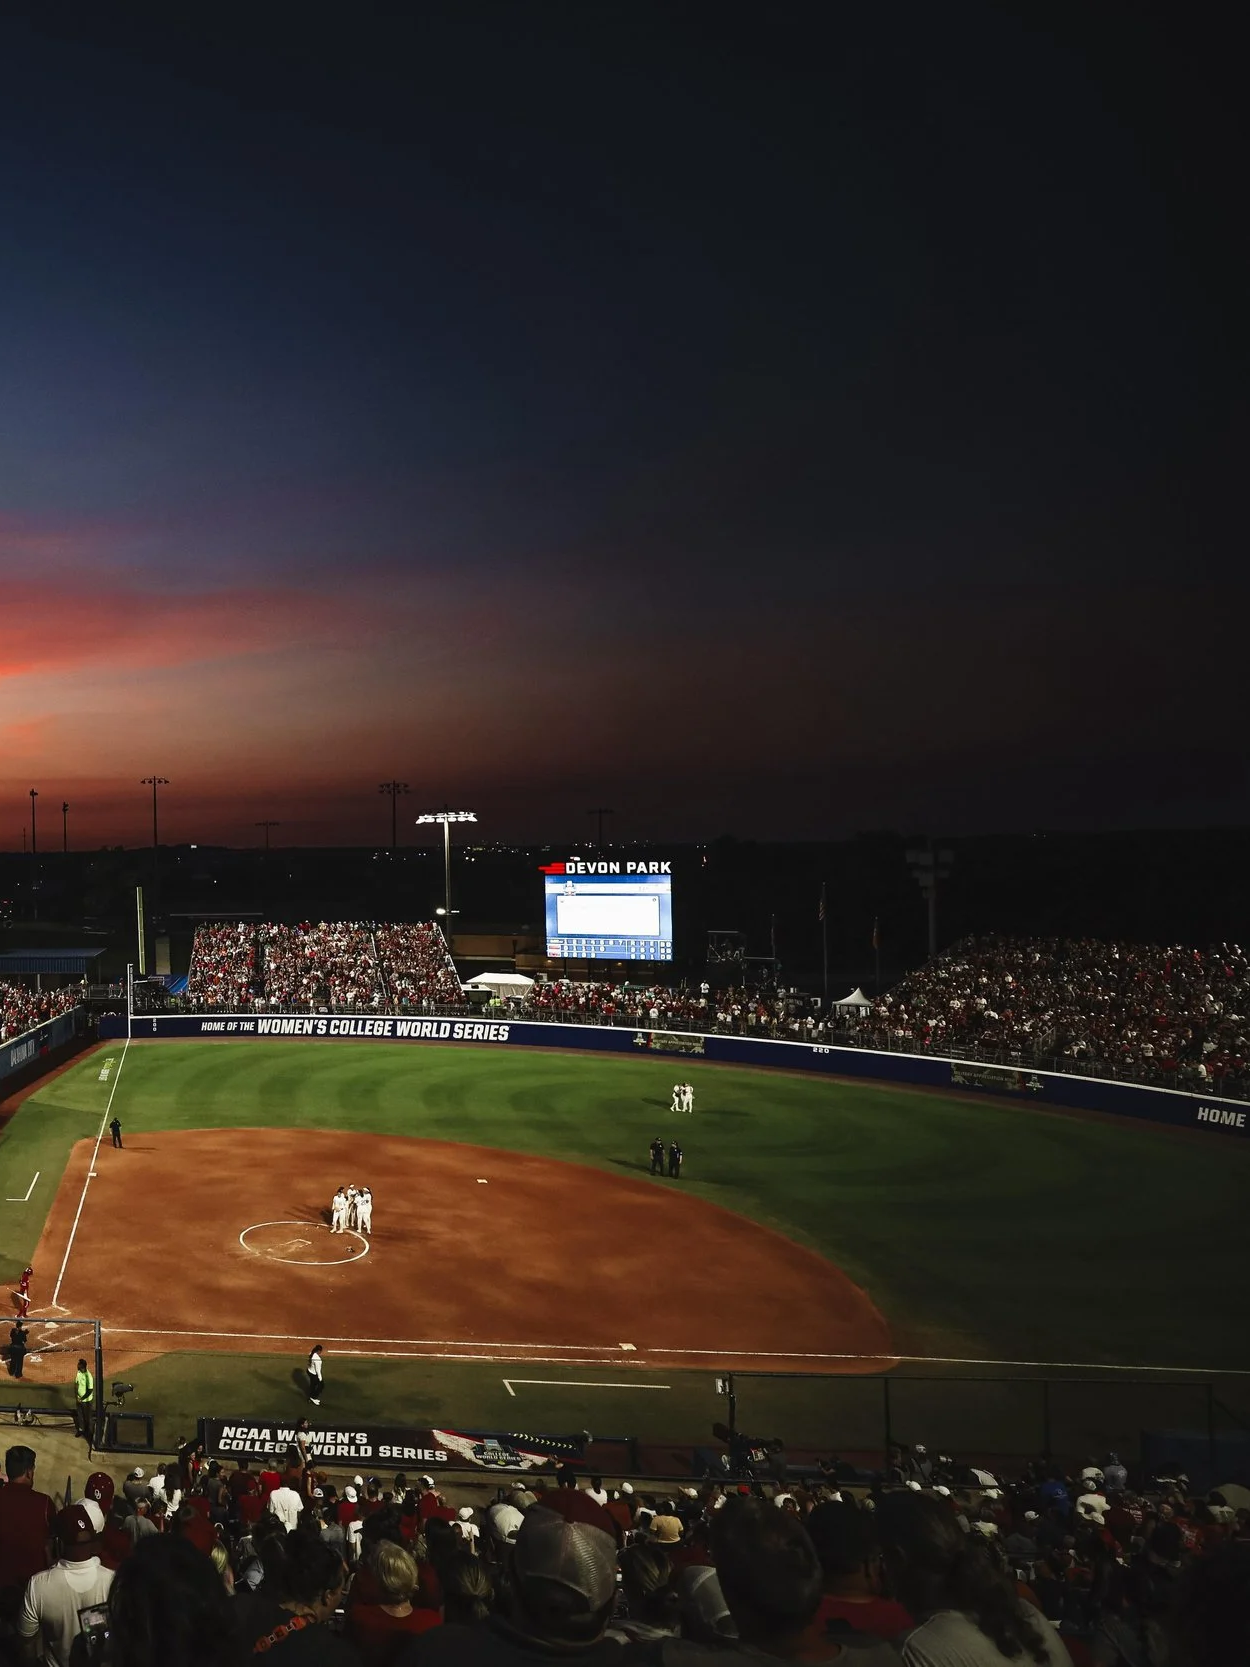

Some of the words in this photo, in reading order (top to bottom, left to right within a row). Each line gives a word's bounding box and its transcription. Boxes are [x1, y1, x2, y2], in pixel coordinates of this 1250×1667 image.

[565, 862, 620, 874] DEVON
[627, 861, 672, 874] PARK
[201, 1022, 225, 1031] HOME
[226, 1022, 238, 1031] OF
[240, 1022, 255, 1031] THE
[257, 1019, 327, 1035] WOMEN'S
[330, 1019, 393, 1036] COLLEGE
[396, 1021, 450, 1038] WORLD
[453, 1023, 510, 1041] SERIES
[1197, 1106, 1246, 1128] HOME
[222, 1426, 271, 1440] NCAA
[277, 1429, 368, 1444] WMEN'S
[218, 1439, 296, 1453] COLLEG
[311, 1444, 372, 1457] WORLD
[378, 1445, 448, 1461] SERIES
